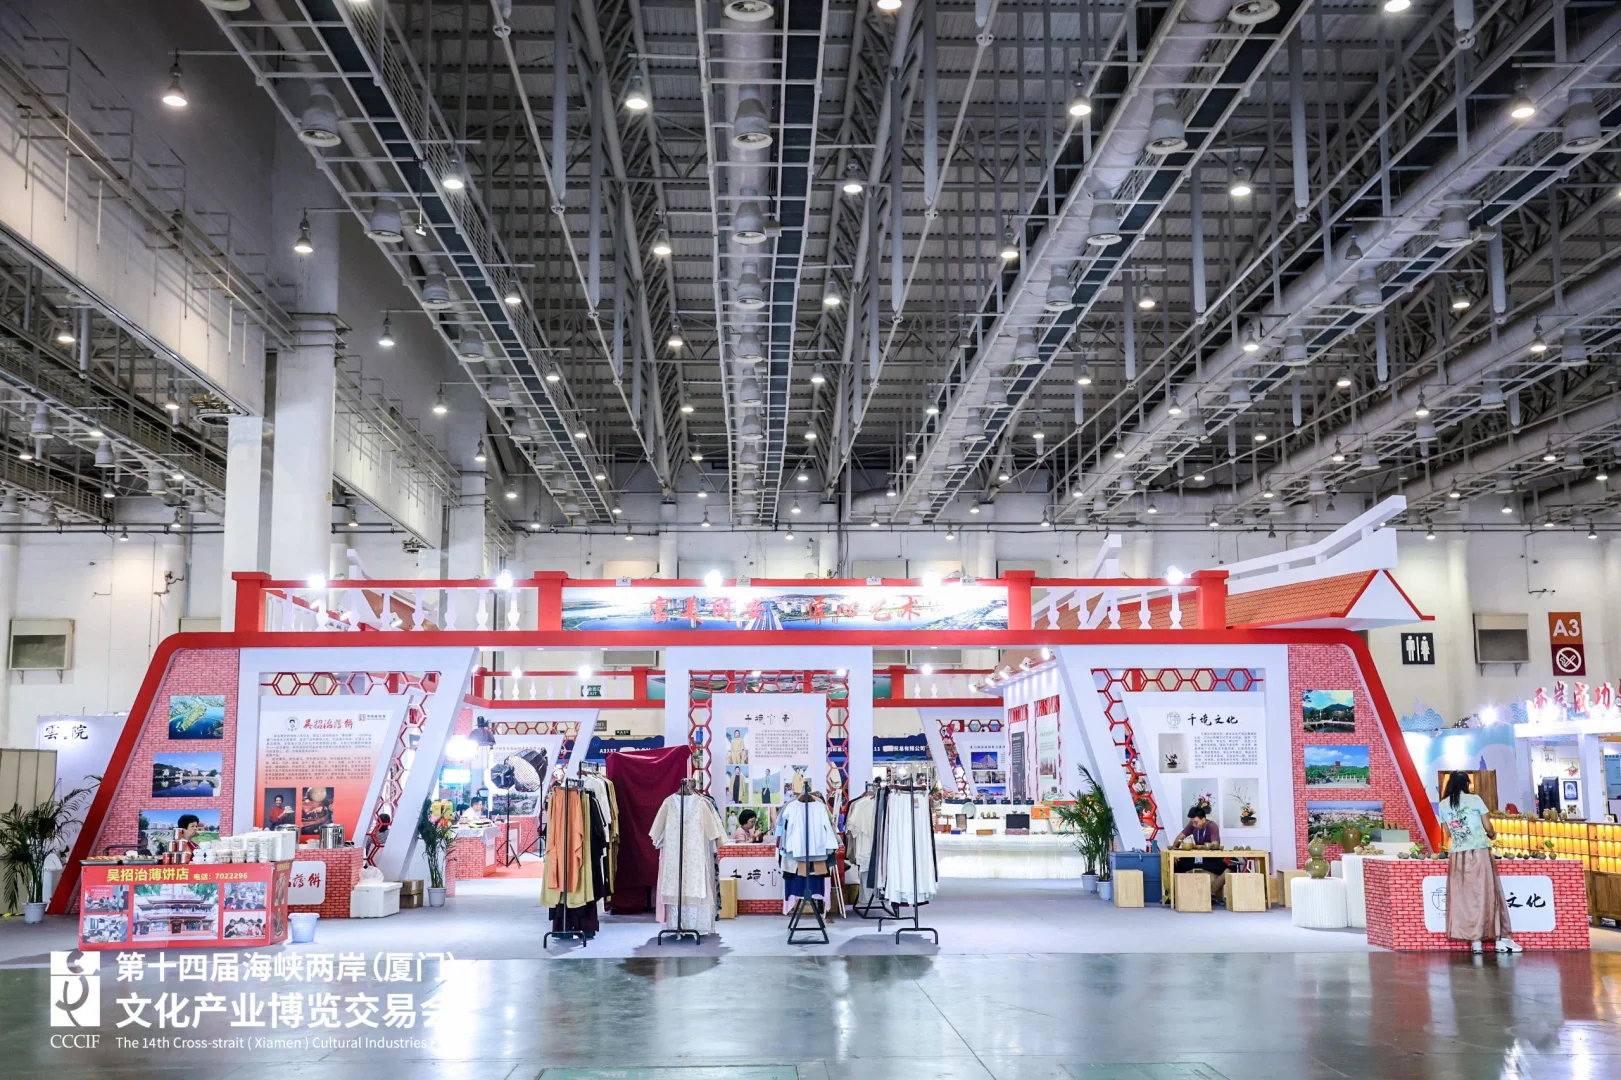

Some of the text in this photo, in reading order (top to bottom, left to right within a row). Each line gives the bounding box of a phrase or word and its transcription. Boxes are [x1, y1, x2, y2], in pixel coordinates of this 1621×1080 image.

[1552, 618, 1580, 637] A3
[1187, 713, 1239, 726] 千境文化
[106, 867, 190, 882] 吴招治薄饼店
[215, 872, 248, 880] 7022296
[1506, 892, 1546, 908] 文化
